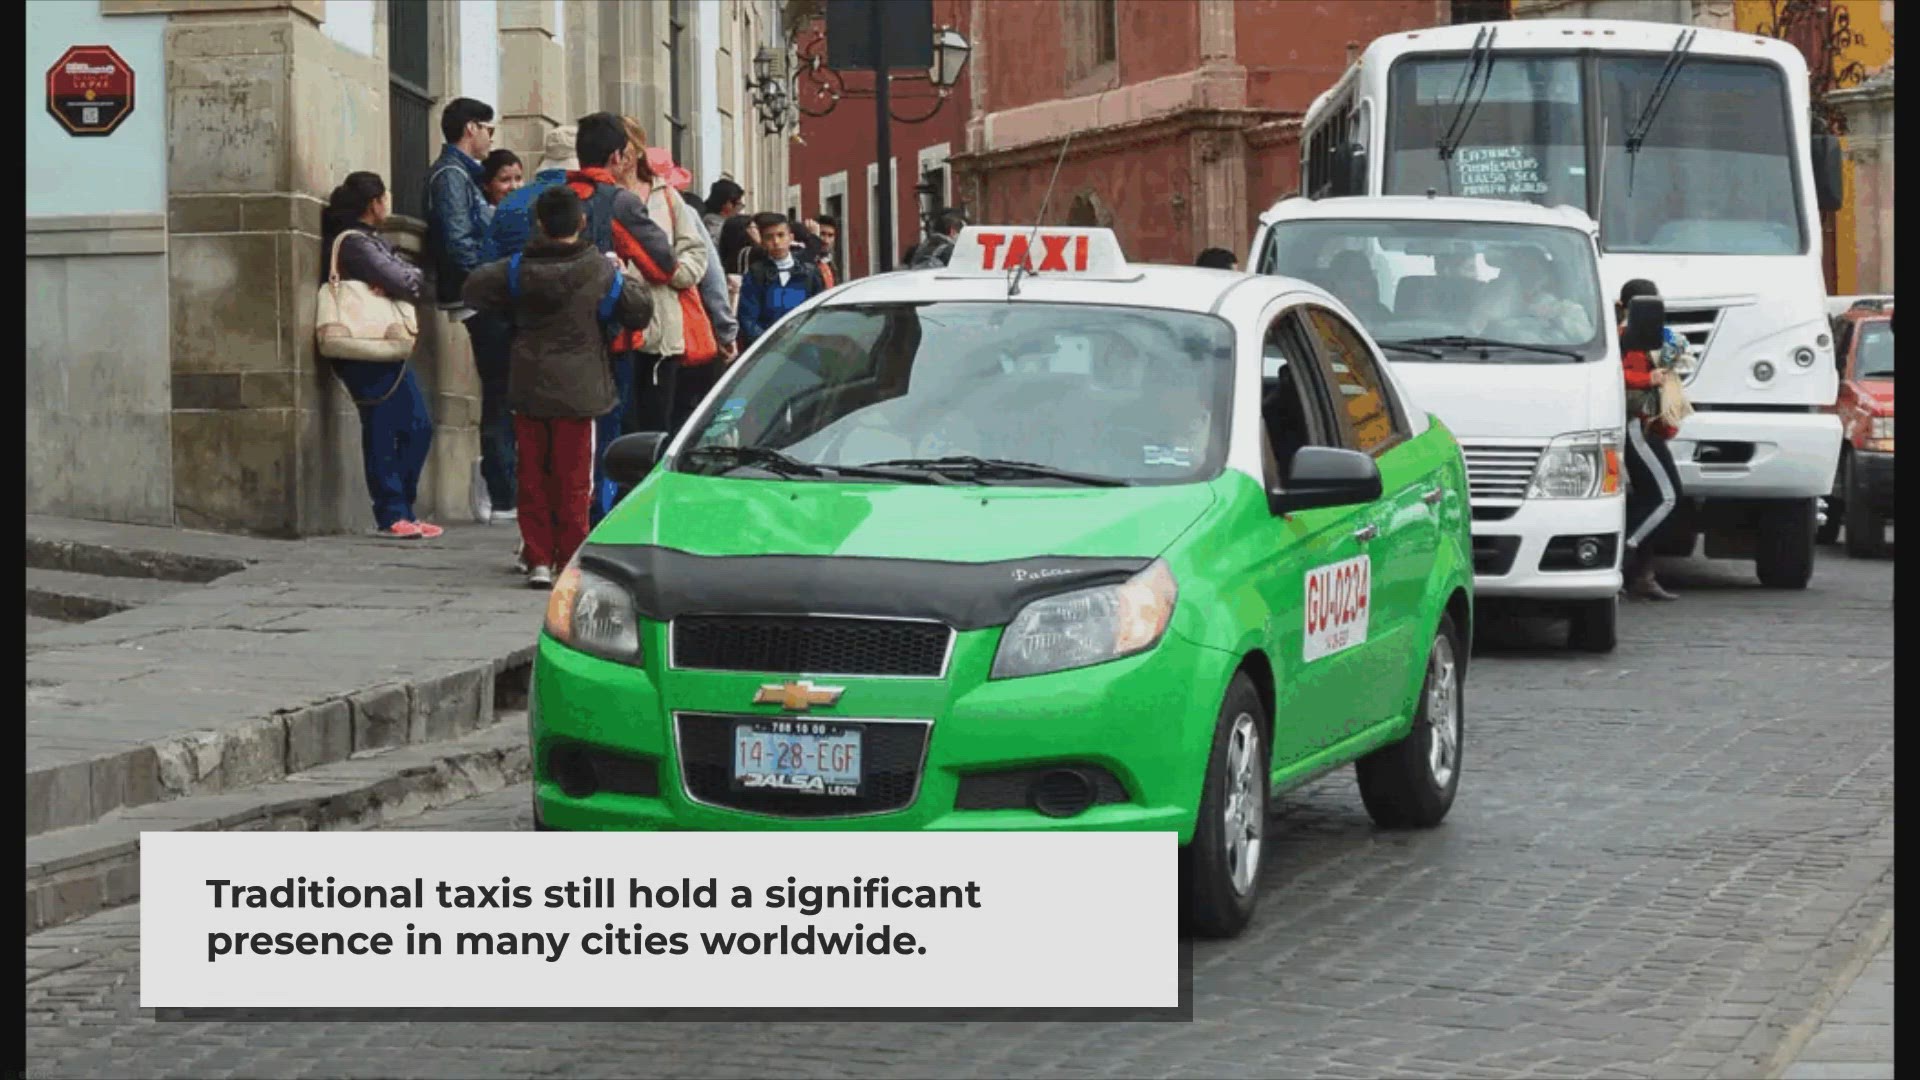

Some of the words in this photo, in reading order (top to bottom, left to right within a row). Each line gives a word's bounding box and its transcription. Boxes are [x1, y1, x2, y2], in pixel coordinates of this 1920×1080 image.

[977, 233, 1089, 272] TAXI
[1308, 560, 1368, 635] GU-0234
[740, 740, 857, 773] 14-28-EGF
